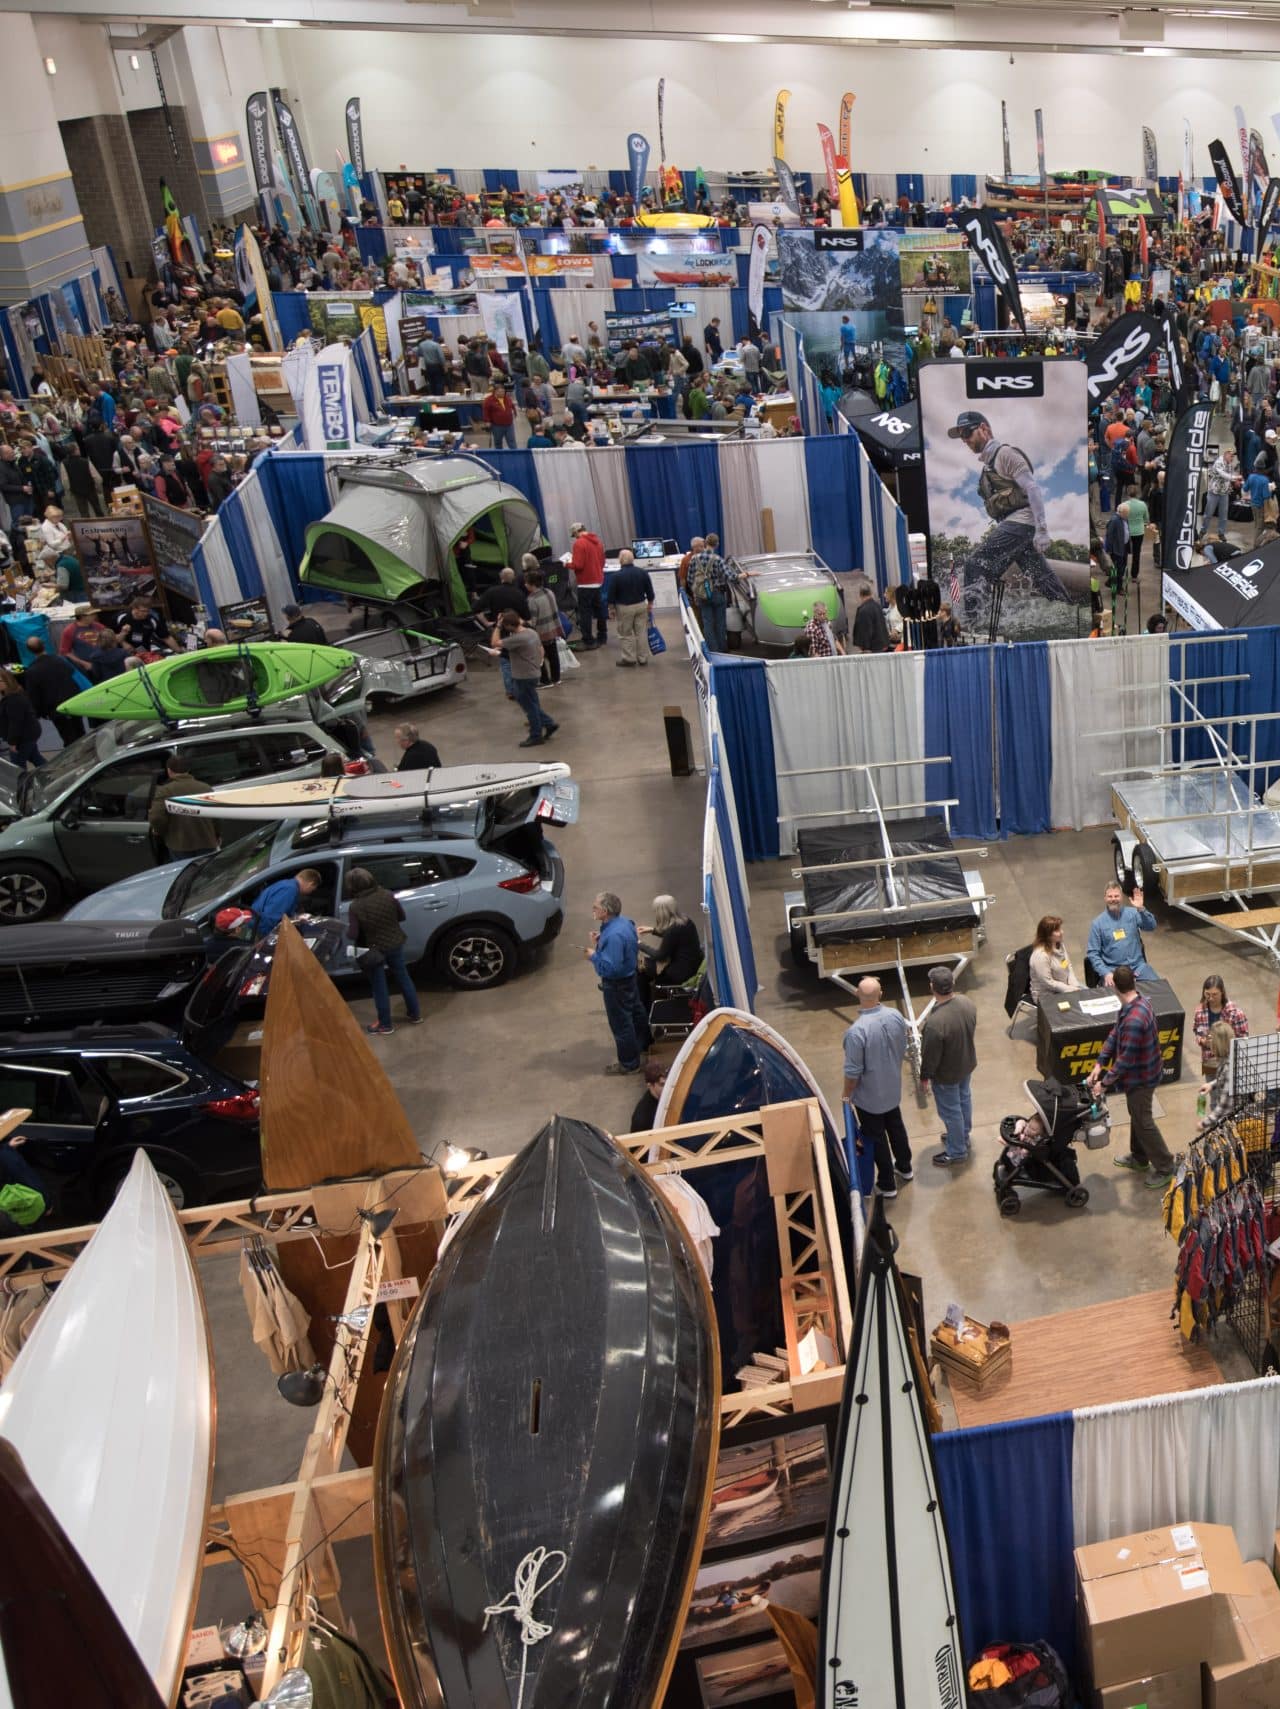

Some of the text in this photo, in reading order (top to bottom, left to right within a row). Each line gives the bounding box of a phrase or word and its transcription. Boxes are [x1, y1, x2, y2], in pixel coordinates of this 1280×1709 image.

[820, 237, 858, 247] NRS
[966, 219, 1010, 285] NRS
[976, 376, 1034, 390] NRS
[1087, 326, 1151, 398] NRS
[321, 366, 345, 439] TEMBO
[870, 412, 912, 434] NRS
[1177, 410, 1209, 546] bonafide
[1215, 561, 1260, 600] bonafide
